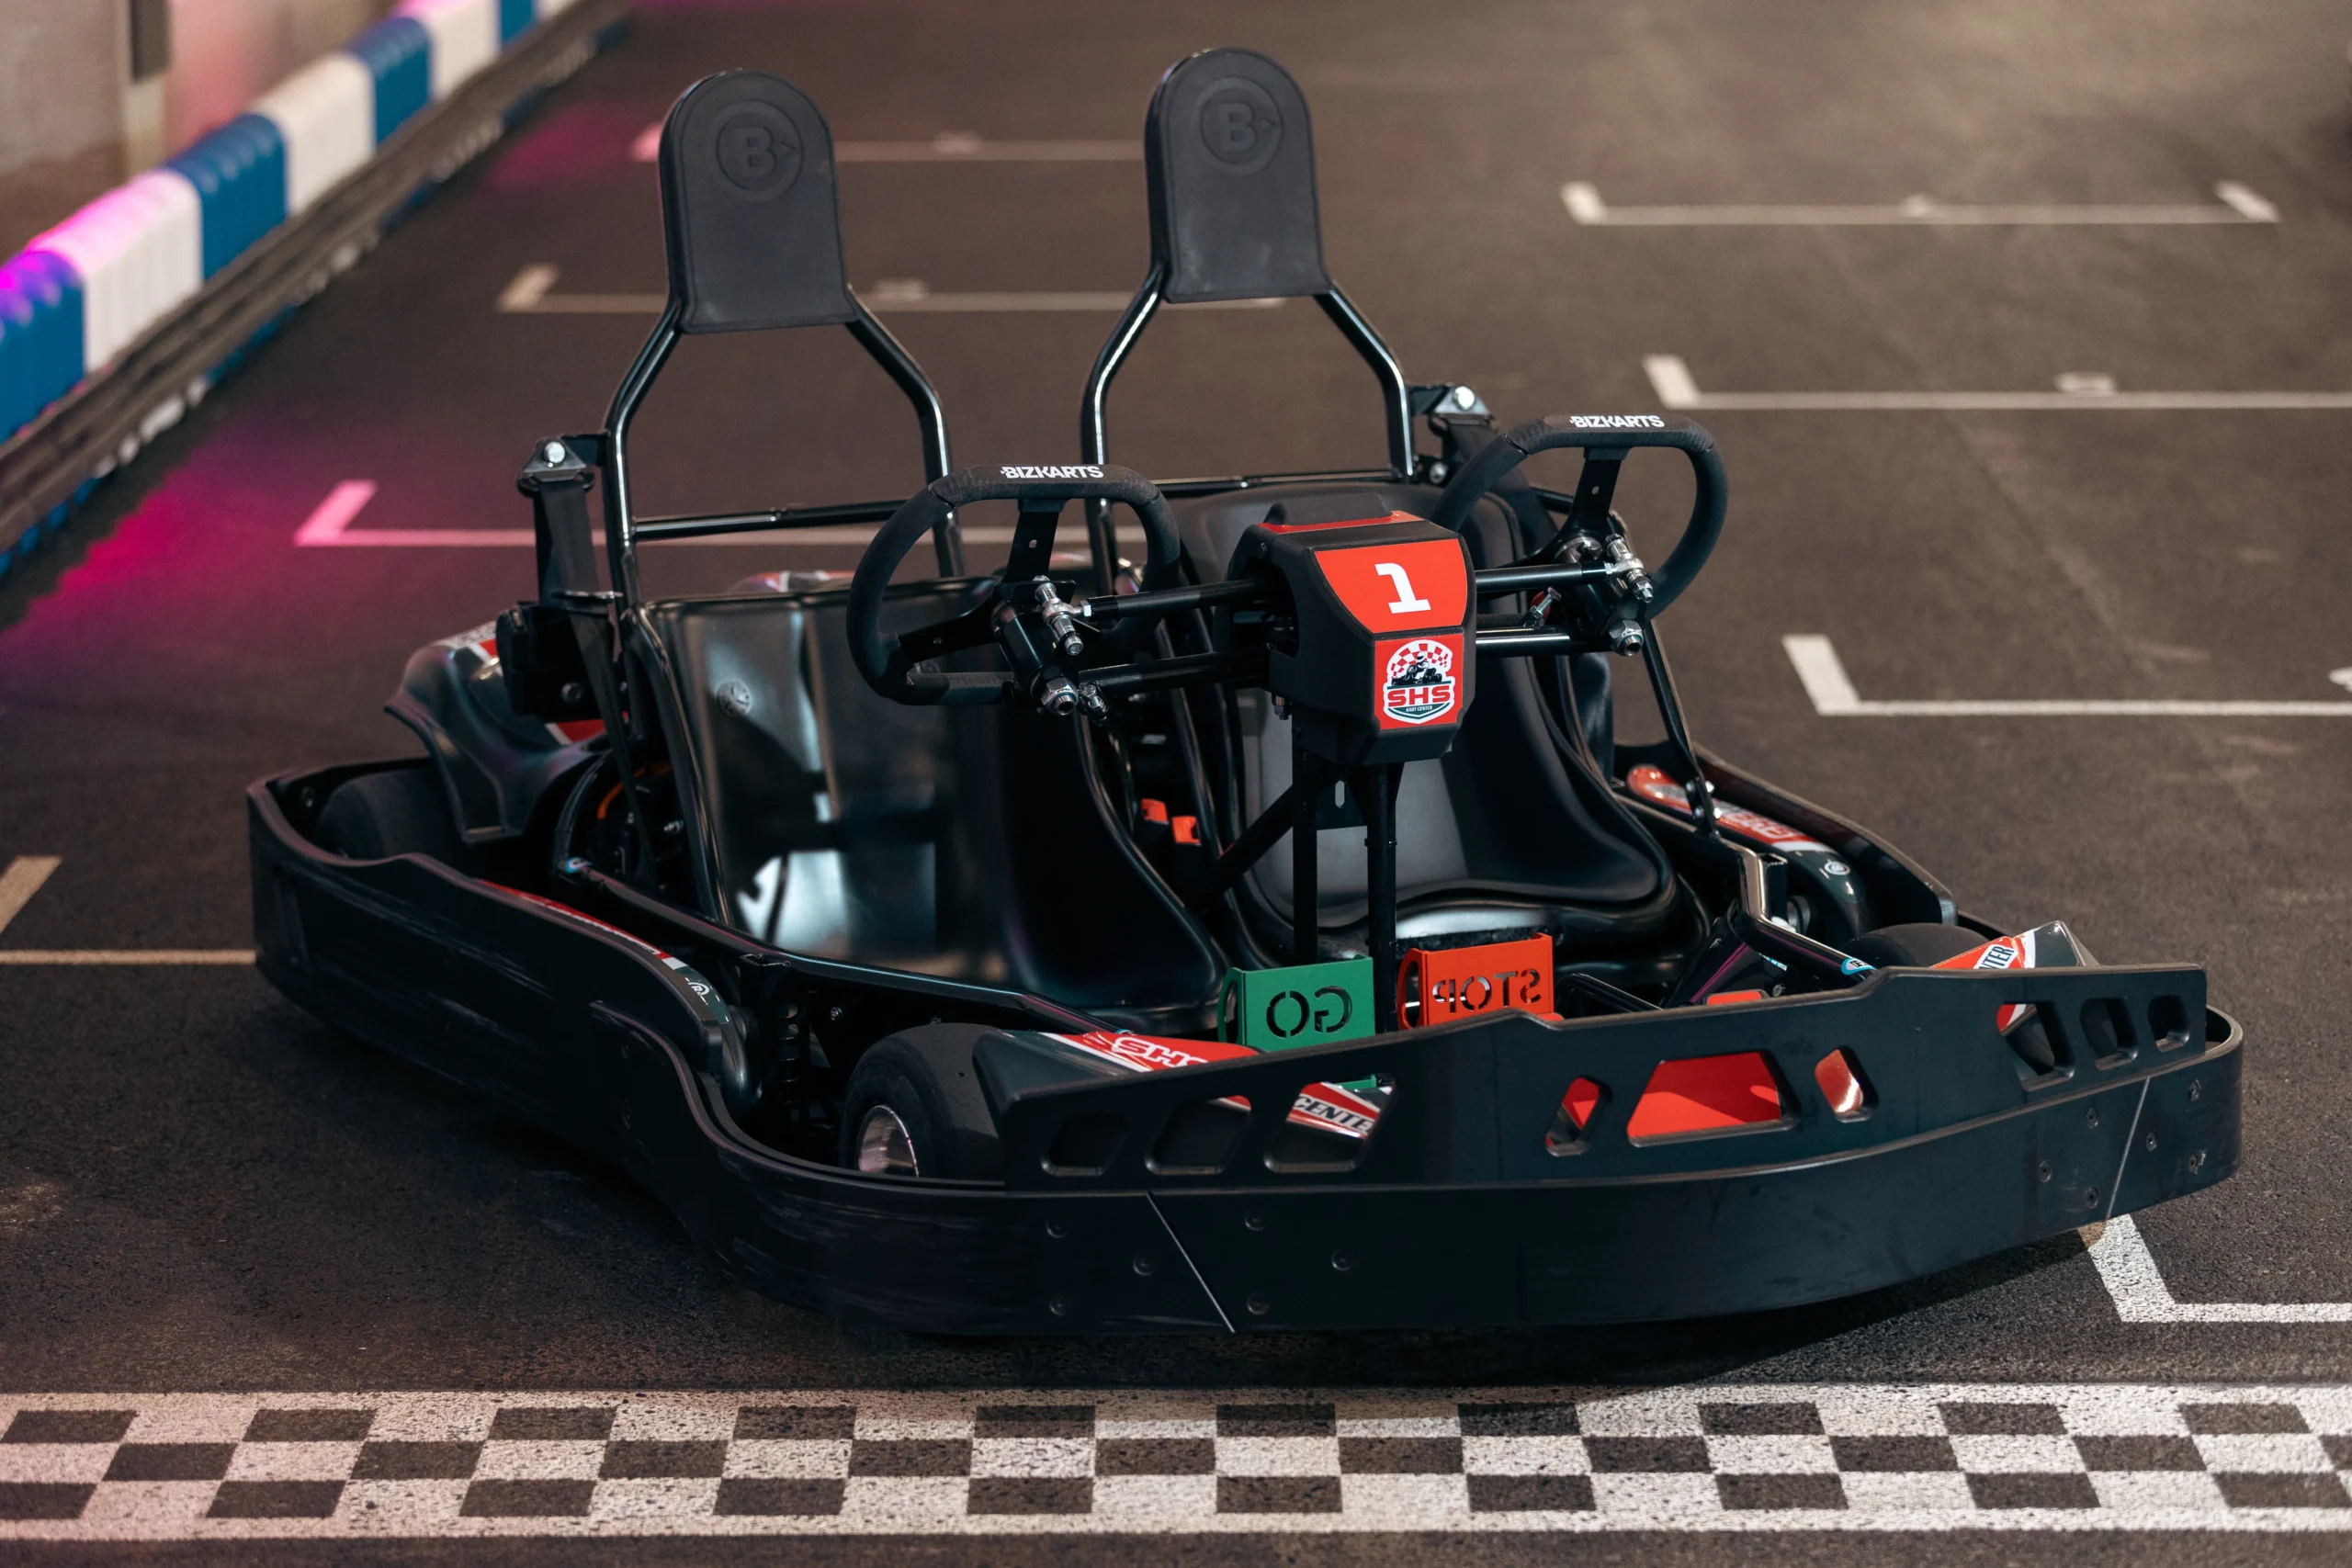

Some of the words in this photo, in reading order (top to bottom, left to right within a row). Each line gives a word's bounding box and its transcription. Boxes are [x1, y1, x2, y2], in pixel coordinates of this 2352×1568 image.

[1568, 415, 1665, 428] BIZKARTS
[1001, 466, 1104, 479] BIZKARTS
[1374, 562, 1431, 615] 1
[1387, 685, 1451, 706] SHS
[1288, 1096, 1375, 1134] CENTE
